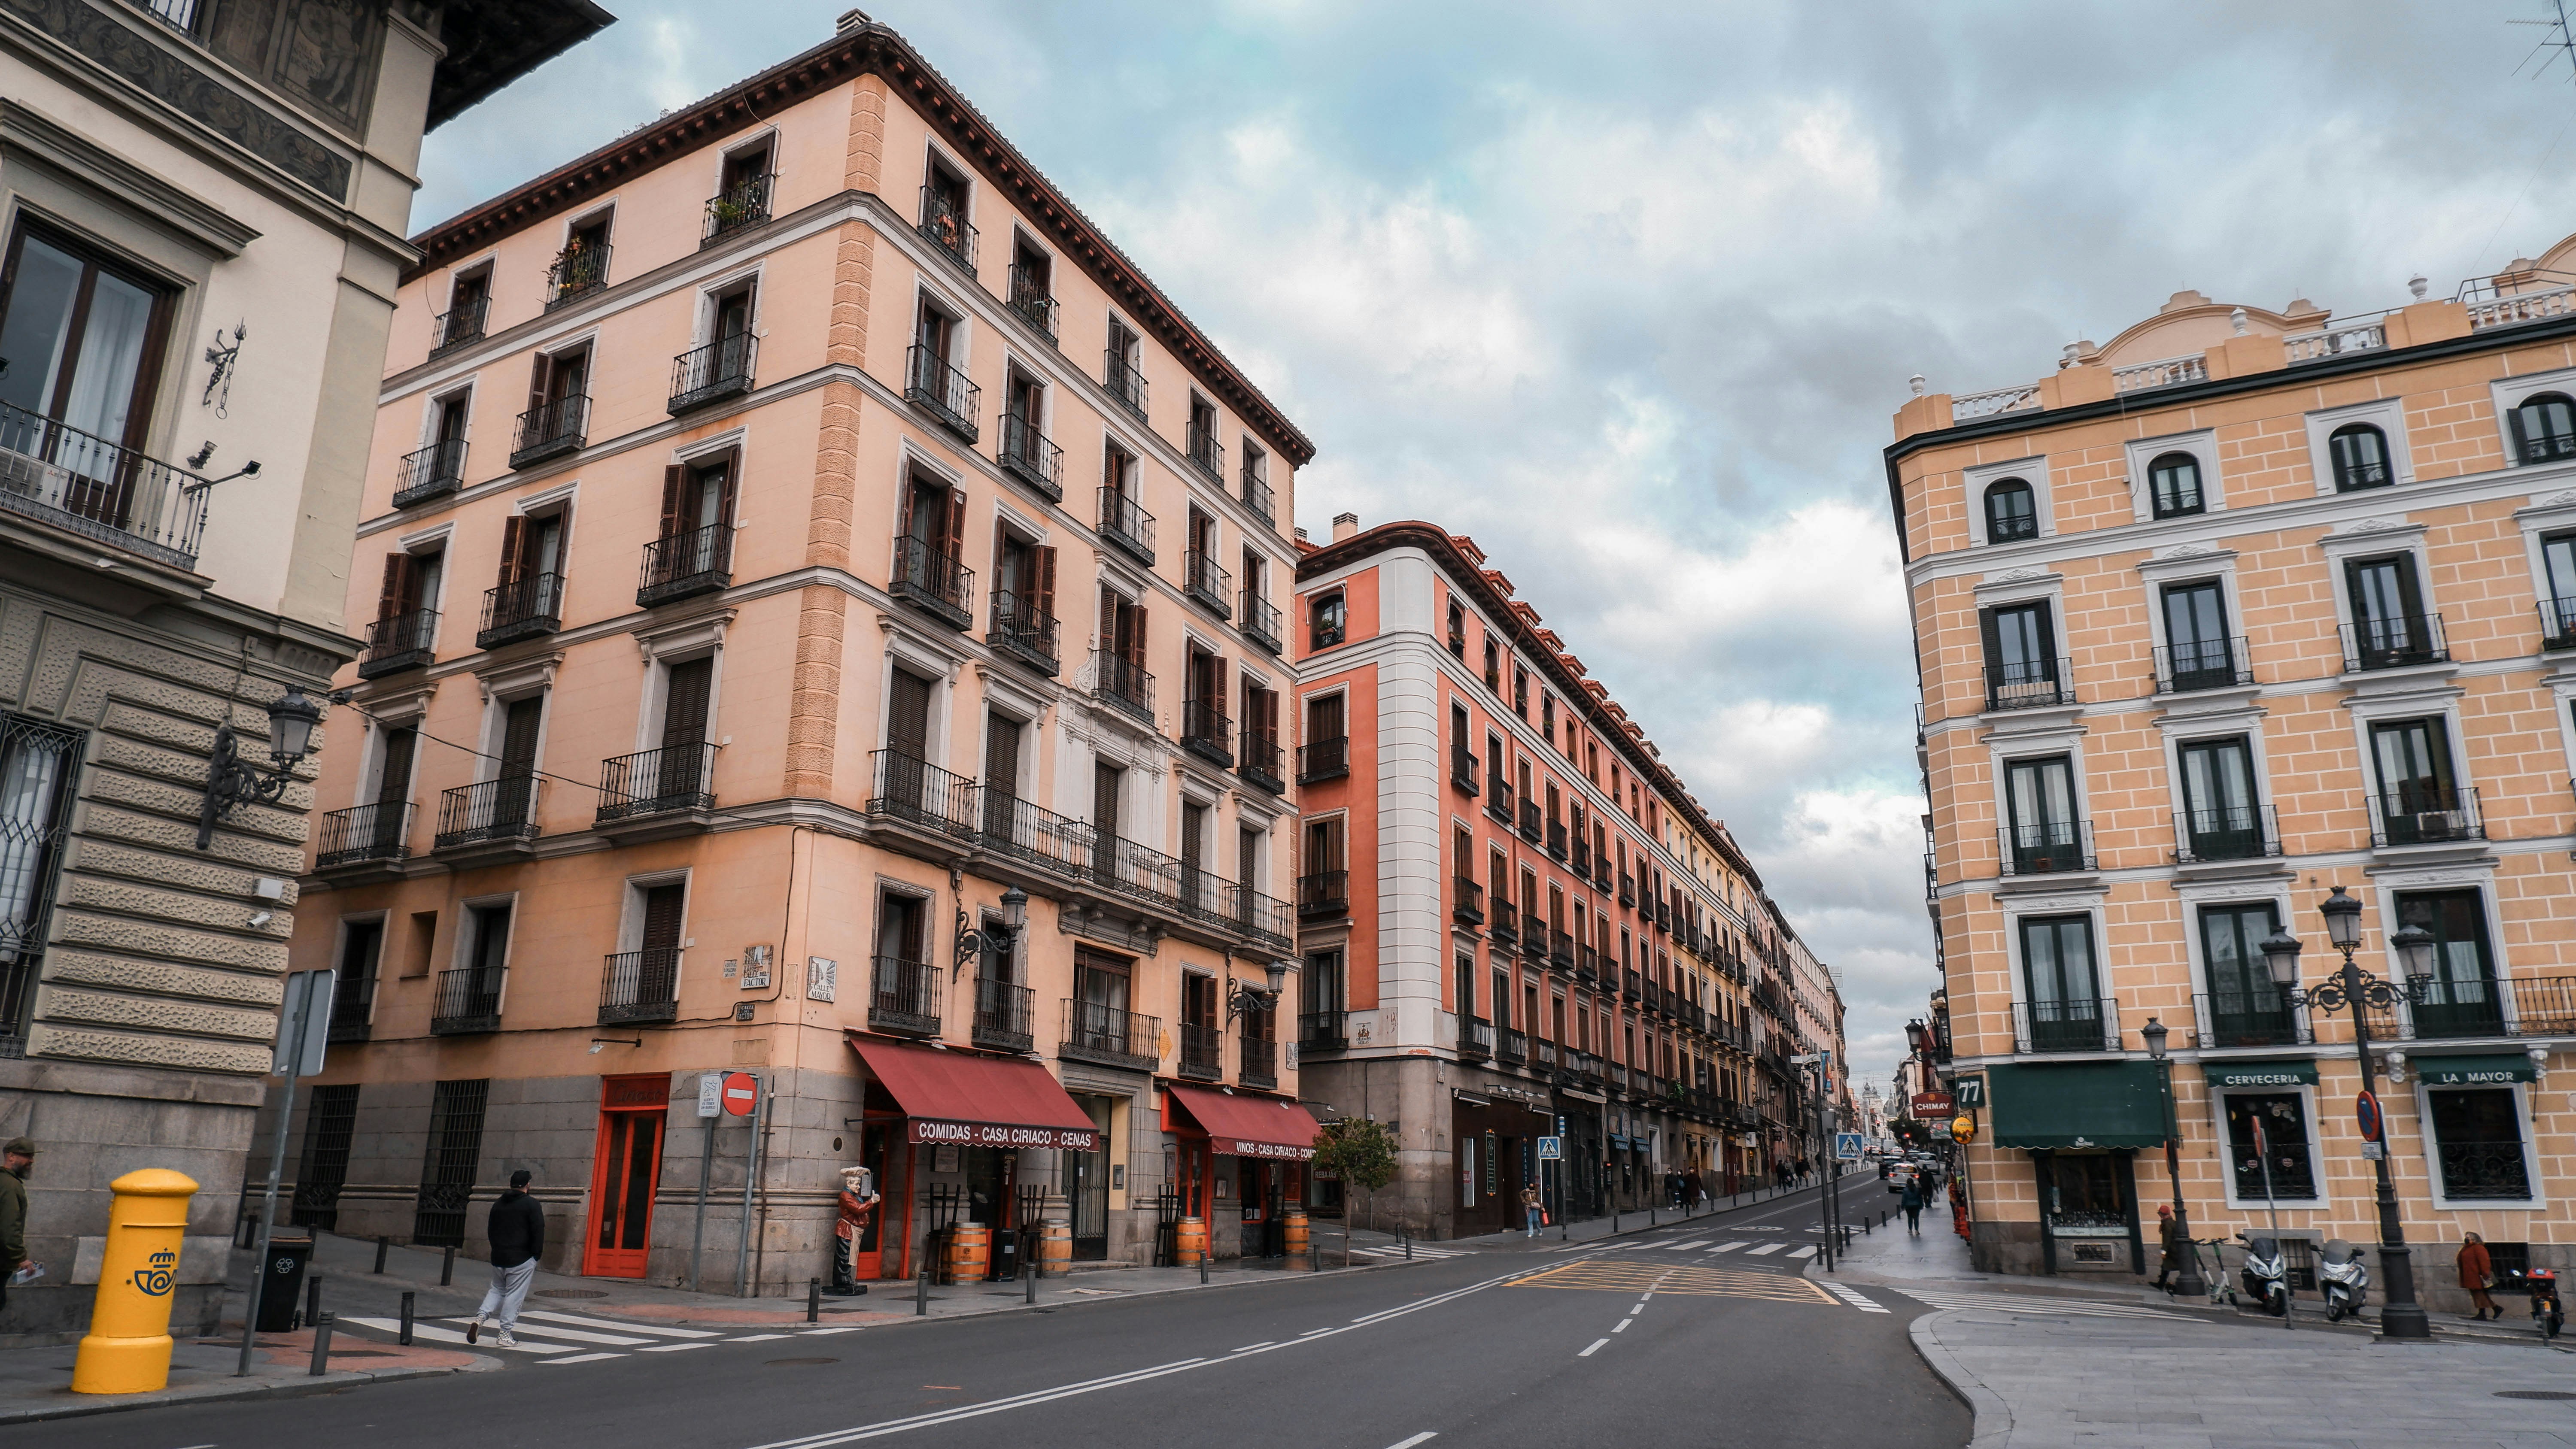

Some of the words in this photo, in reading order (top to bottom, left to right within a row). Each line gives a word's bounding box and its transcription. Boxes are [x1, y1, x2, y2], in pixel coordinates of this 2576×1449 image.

[744, 978, 766, 987] FACTOR
[814, 984, 830, 992] CALLE
[811, 991, 832, 1002] MAYOR
[2226, 1074, 2301, 1084] CERVECERIA
[2442, 1073, 2459, 1082] LA
[2468, 1072, 2514, 1081] MAYOR
[1959, 1081, 1980, 1102] 77
[919, 1122, 970, 1140] COMIDAS
[982, 1127, 1009, 1142] CASA
[1012, 1129, 1051, 1144] CIRIACO
[1061, 1132, 1091, 1147] CENAS
[1236, 1142, 1255, 1154] VINOS
[1258, 1144, 1273, 1155] CASA
